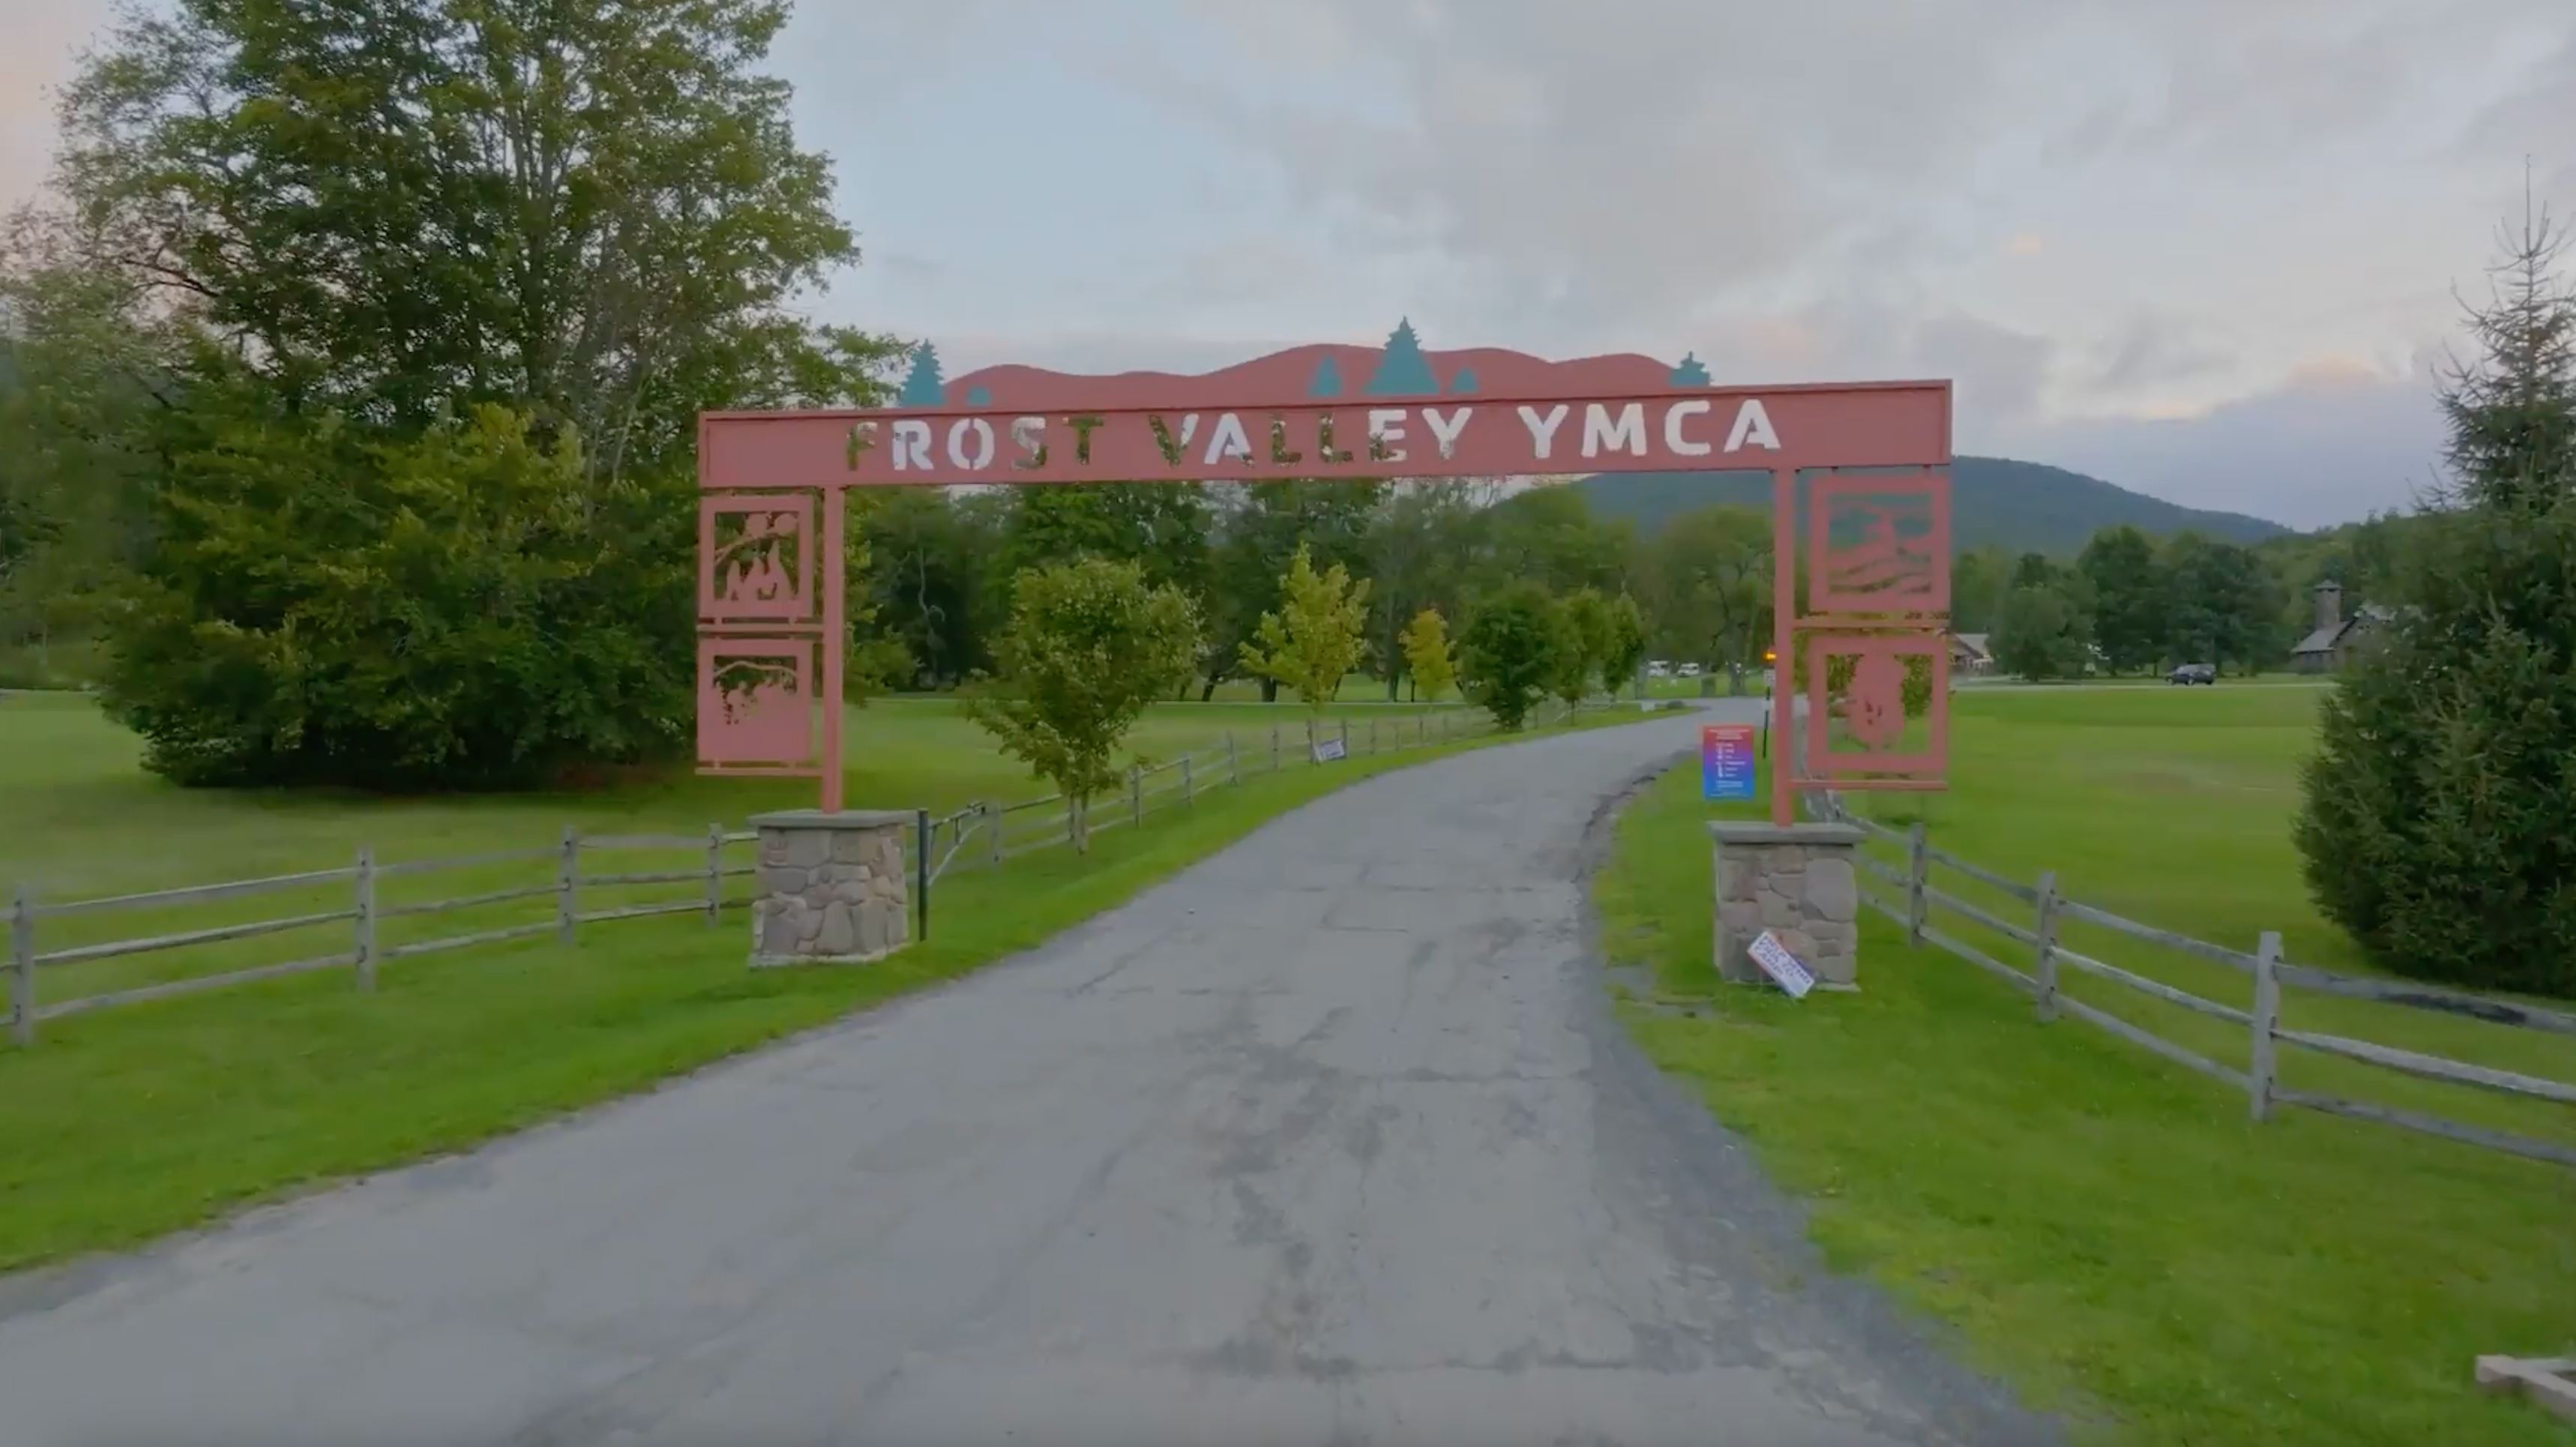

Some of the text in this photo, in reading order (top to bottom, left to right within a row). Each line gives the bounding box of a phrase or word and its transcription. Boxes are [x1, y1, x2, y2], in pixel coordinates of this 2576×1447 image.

[847, 398, 1781, 471] FROST VALLEY YMCA
